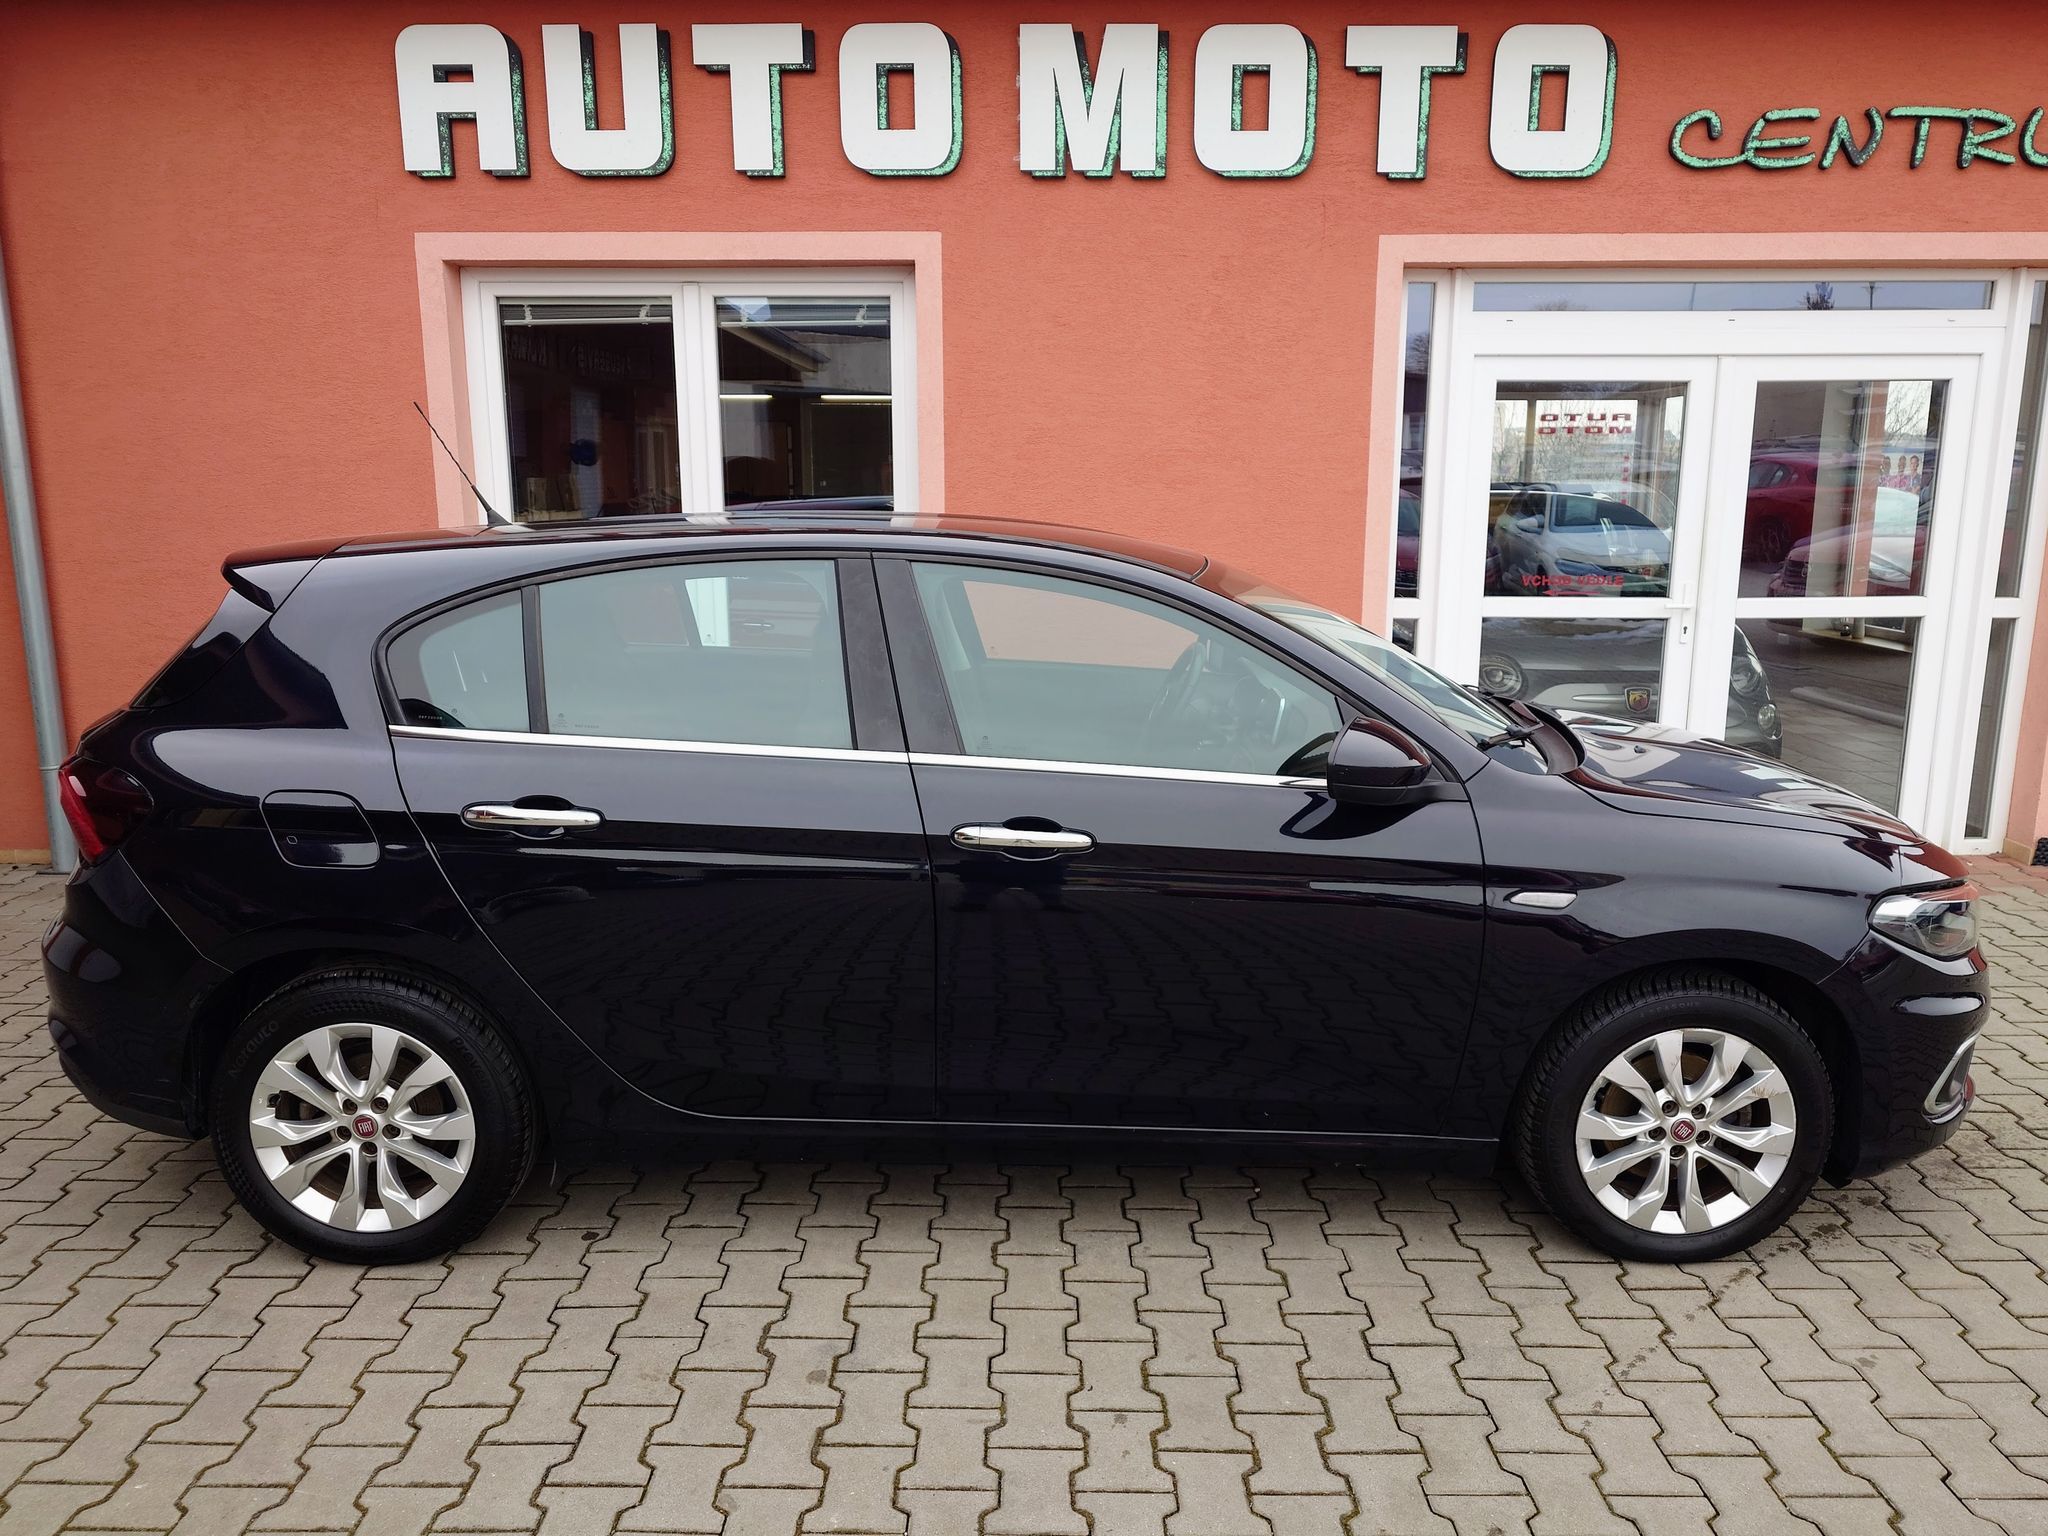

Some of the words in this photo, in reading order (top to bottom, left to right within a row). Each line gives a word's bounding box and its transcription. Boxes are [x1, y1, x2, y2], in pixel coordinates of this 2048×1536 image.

[394, 22, 963, 178] AUTO
[1018, 23, 1618, 179] MOTO
[357, 1120, 373, 1134] FIAT
[1675, 1123, 1692, 1139] FIAT
